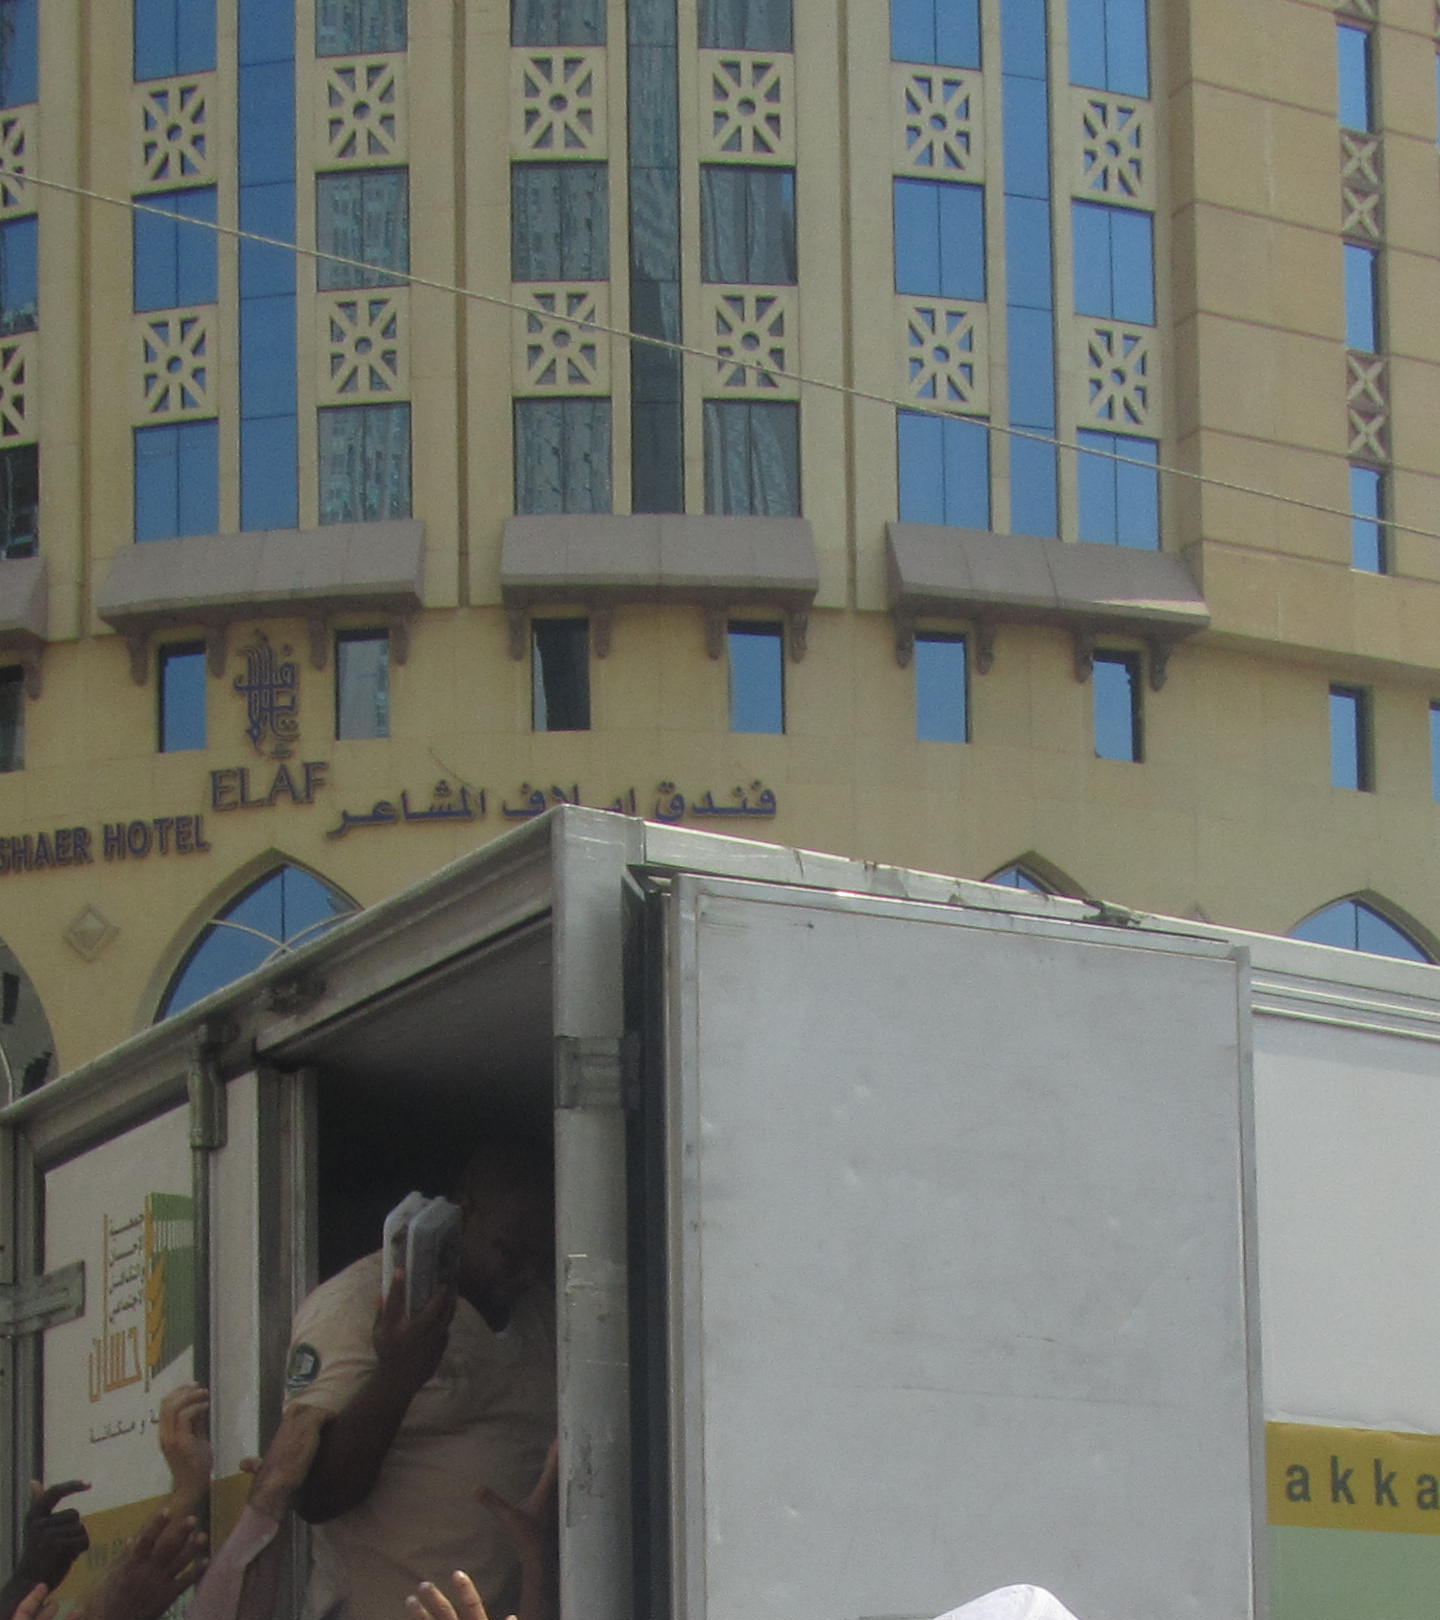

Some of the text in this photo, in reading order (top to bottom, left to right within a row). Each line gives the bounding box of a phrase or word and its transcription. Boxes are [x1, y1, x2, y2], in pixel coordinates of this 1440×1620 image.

[210, 761, 329, 812] ELAF
[326, 778, 486, 838] المشاعر
[654, 779, 777, 822] فندق
[102, 814, 212, 862] HOTEL
